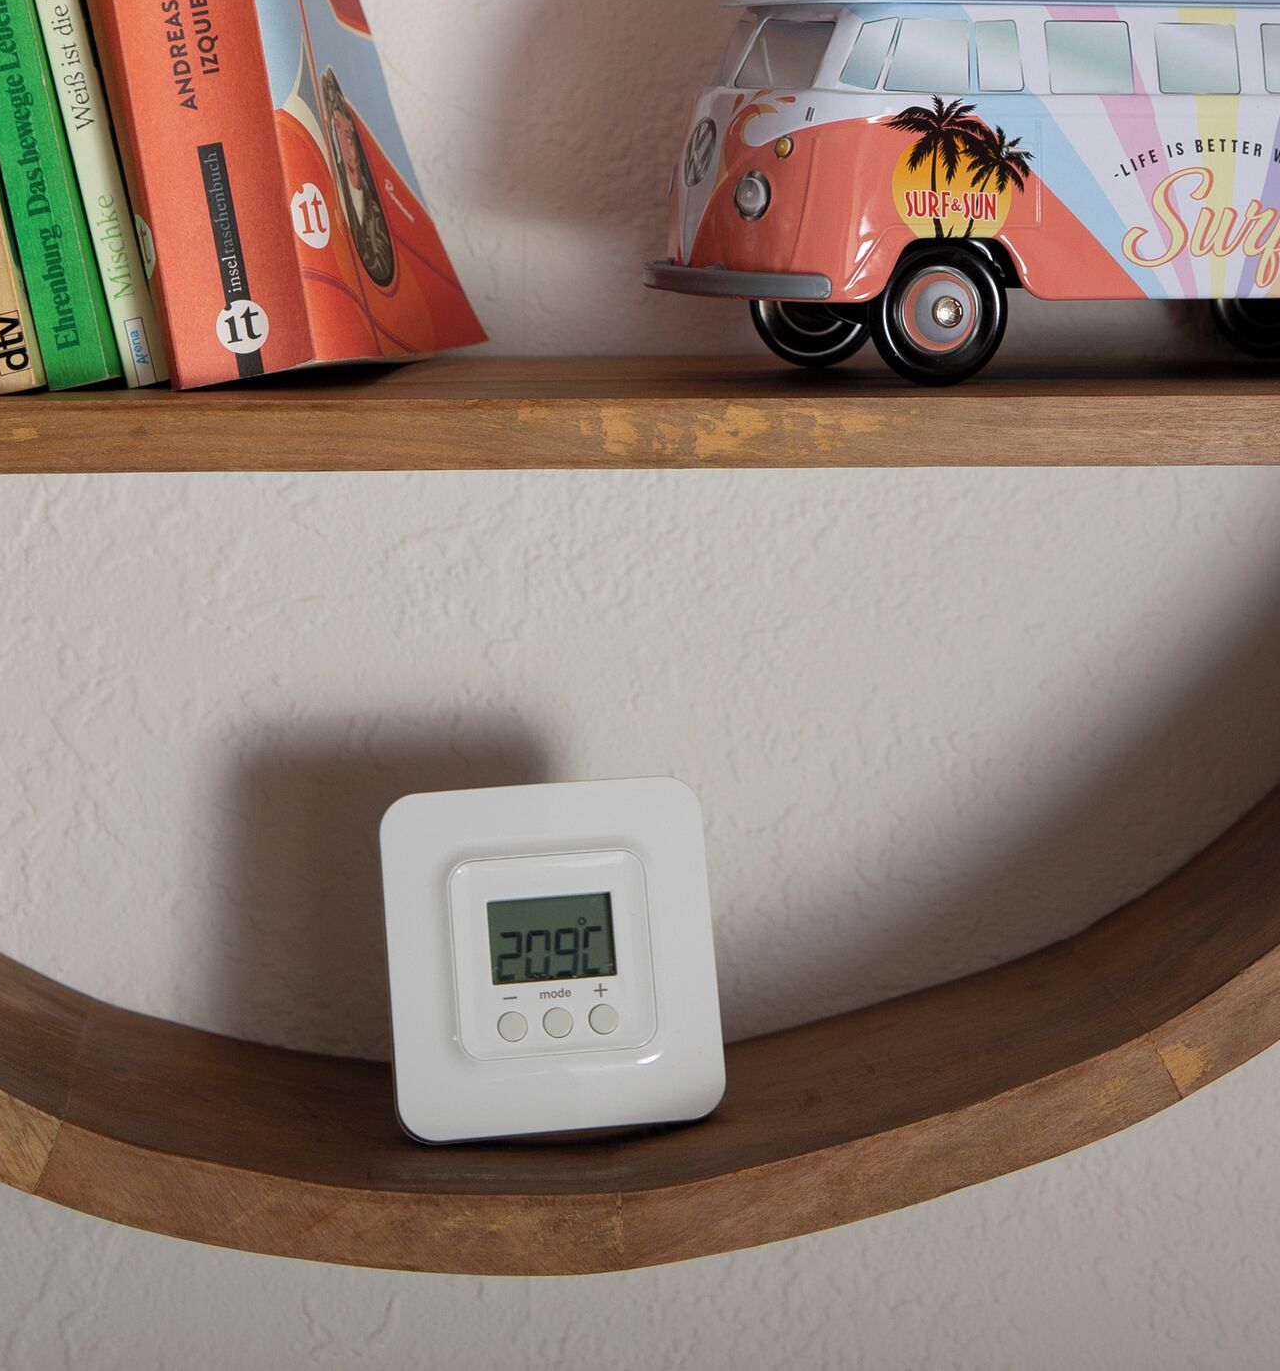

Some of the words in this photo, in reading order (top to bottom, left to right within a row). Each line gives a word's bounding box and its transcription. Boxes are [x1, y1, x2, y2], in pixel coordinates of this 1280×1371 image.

[53, 3, 75, 37] die
[60, 40, 81, 68] ist
[6, 73, 45, 167] bewegte
[63, 71, 95, 131] Weiß
[1166, 142, 1185, 158] IS
[1195, 138, 1263, 158] BETTER
[26, 166, 51, 218] Das
[297, 187, 327, 235] it
[204, 151, 243, 294] inseltaschenbuch
[96, 194, 136, 301] Mischke
[39, 224, 81, 351] Ehrenburg
[131, 330, 150, 365] Arena
[223, 303, 263, 345] it
[539, 987, 572, 1000] mode
